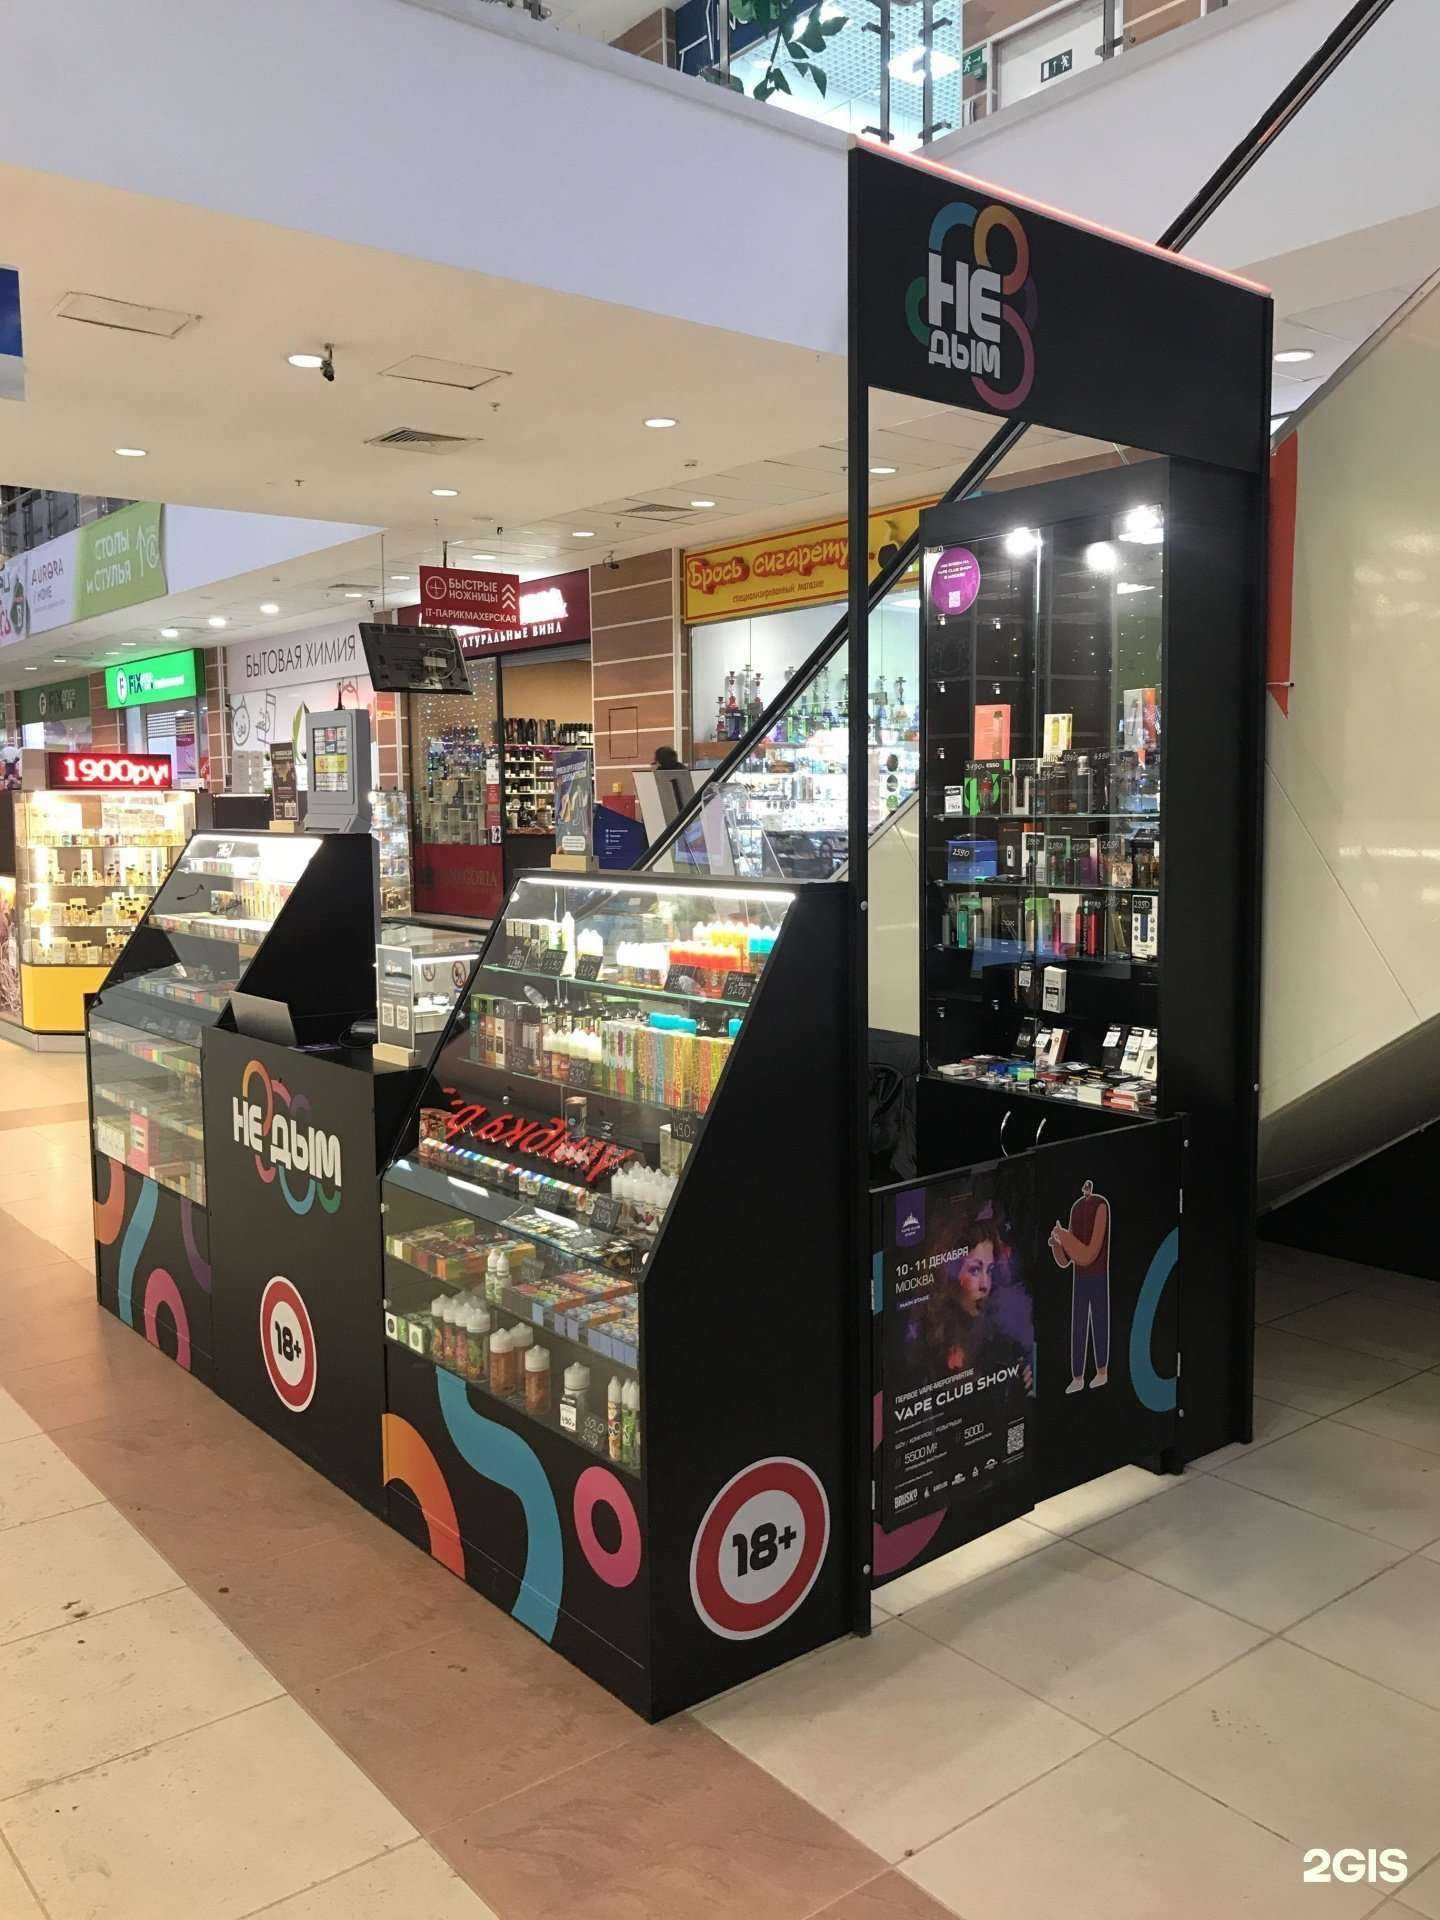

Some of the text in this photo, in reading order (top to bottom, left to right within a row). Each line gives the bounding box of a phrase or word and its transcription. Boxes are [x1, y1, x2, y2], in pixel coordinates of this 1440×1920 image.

[95, 528, 131, 561] СТОЛЫ
[31, 557, 65, 587] AURORA
[94, 559, 132, 592] СТУЛЬЯ
[688, 539, 849, 589] Брось сигарету
[449, 577, 498, 593] БЫСТРЫЕ
[449, 590, 498, 604] НОЖНИЦЫ
[459, 621, 562, 649] АТУРАЛЬНЫЕ ВИНА
[246, 634, 356, 678] БЫТОВАЯ ХИМИЯ
[232, 1096, 263, 1153] НЕ
[895, 1263, 908, 1277] 10
[914, 1259, 927, 1272] 11
[928, 1245, 969, 1270] ДЕКАБРЯ
[895, 1273, 935, 1295] МОСКВА
[274, 1320, 302, 1362] 18+
[894, 1363, 1020, 1422] VAPE CLUB SHOW
[963, 1422, 985, 1440] 5000
[732, 1522, 797, 1578] 18+
